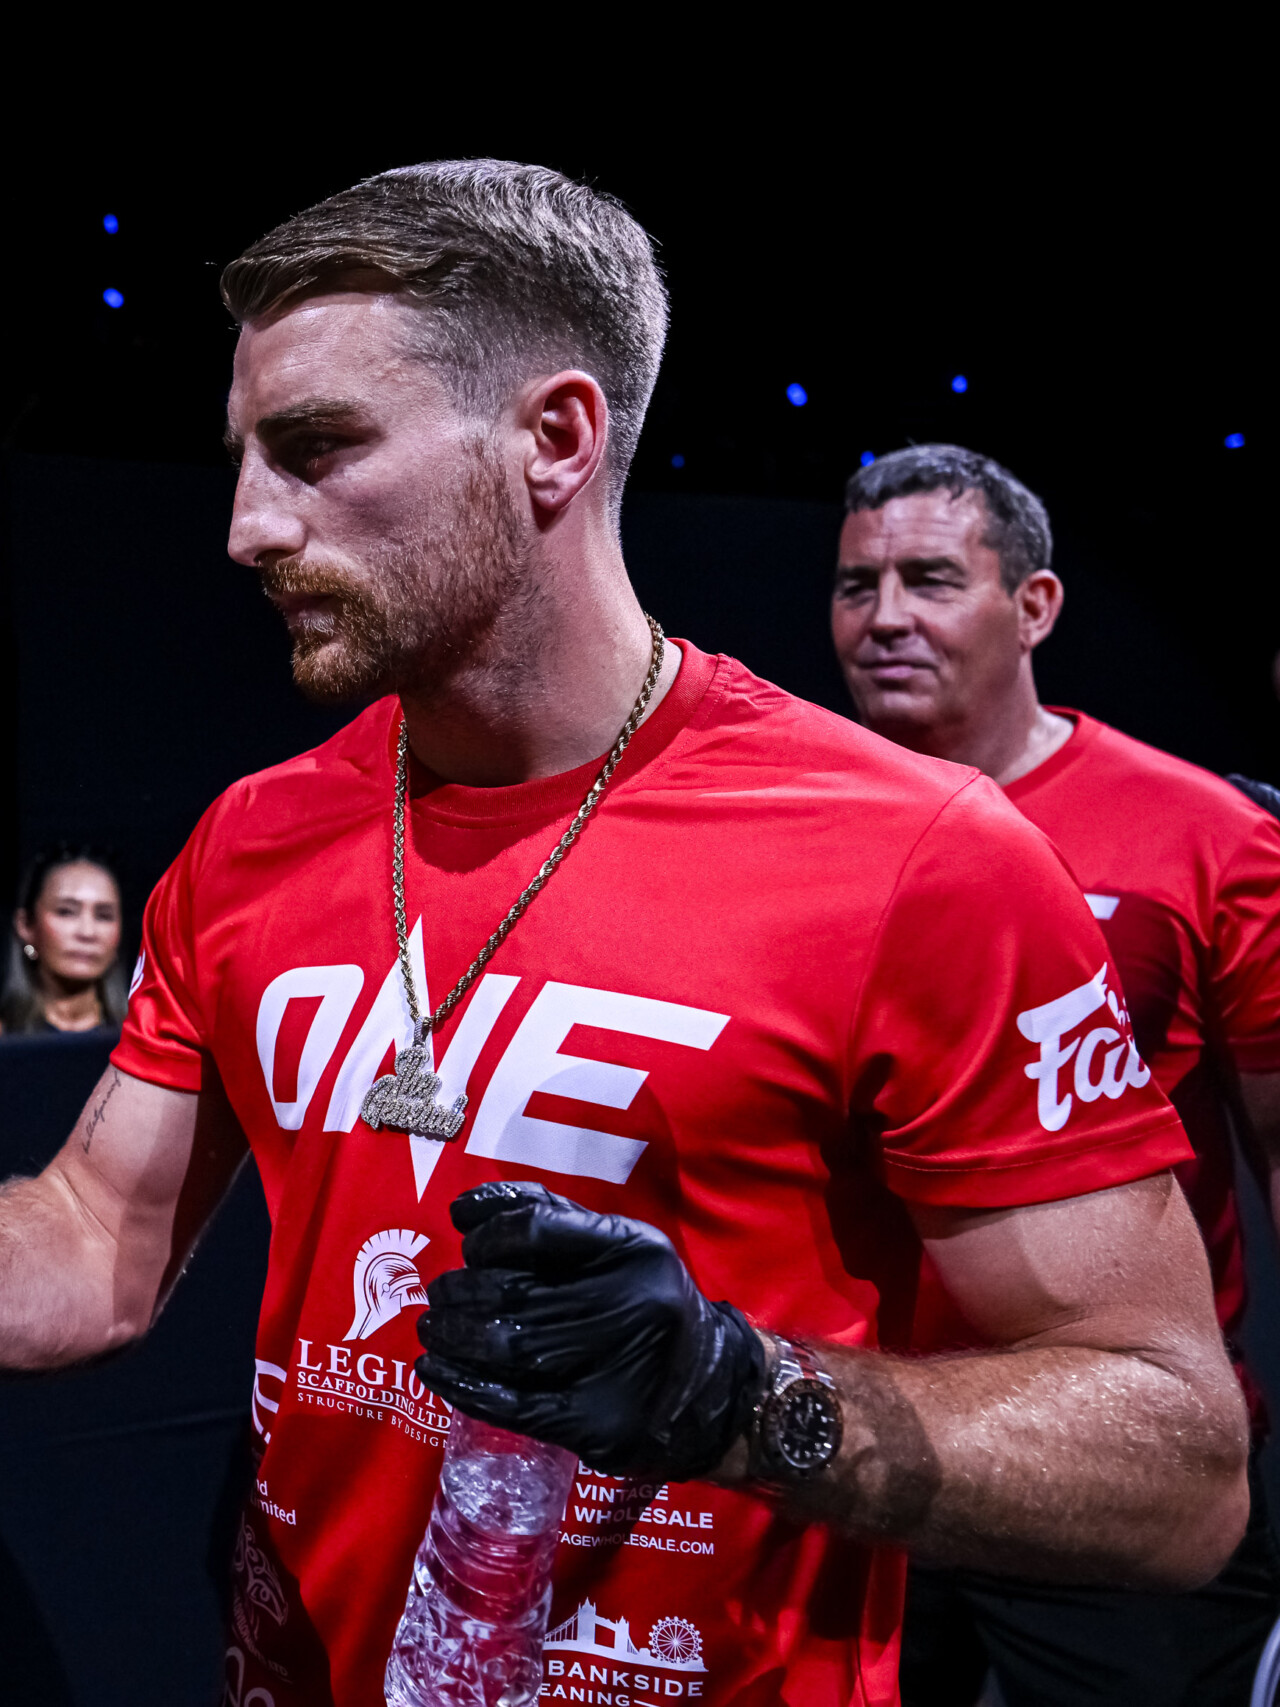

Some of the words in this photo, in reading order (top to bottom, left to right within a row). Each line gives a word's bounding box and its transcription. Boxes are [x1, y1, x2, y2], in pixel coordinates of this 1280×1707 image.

[256, 914, 732, 1204] ONE
[297, 1371, 415, 1416] SCAFFOLDING
[417, 1406, 451, 1429] LTD
[297, 1392, 384, 1421] STRUCTURE
[391, 1415, 403, 1429] BY
[575, 1482, 669, 1503] VINTAGE
[574, 1505, 714, 1529] WHOLESALE
[558, 1530, 715, 1555] AGEWHOLESALE.COM
[547, 1660, 704, 1697] BANKSIDE
[539, 1683, 631, 1707] EANING
